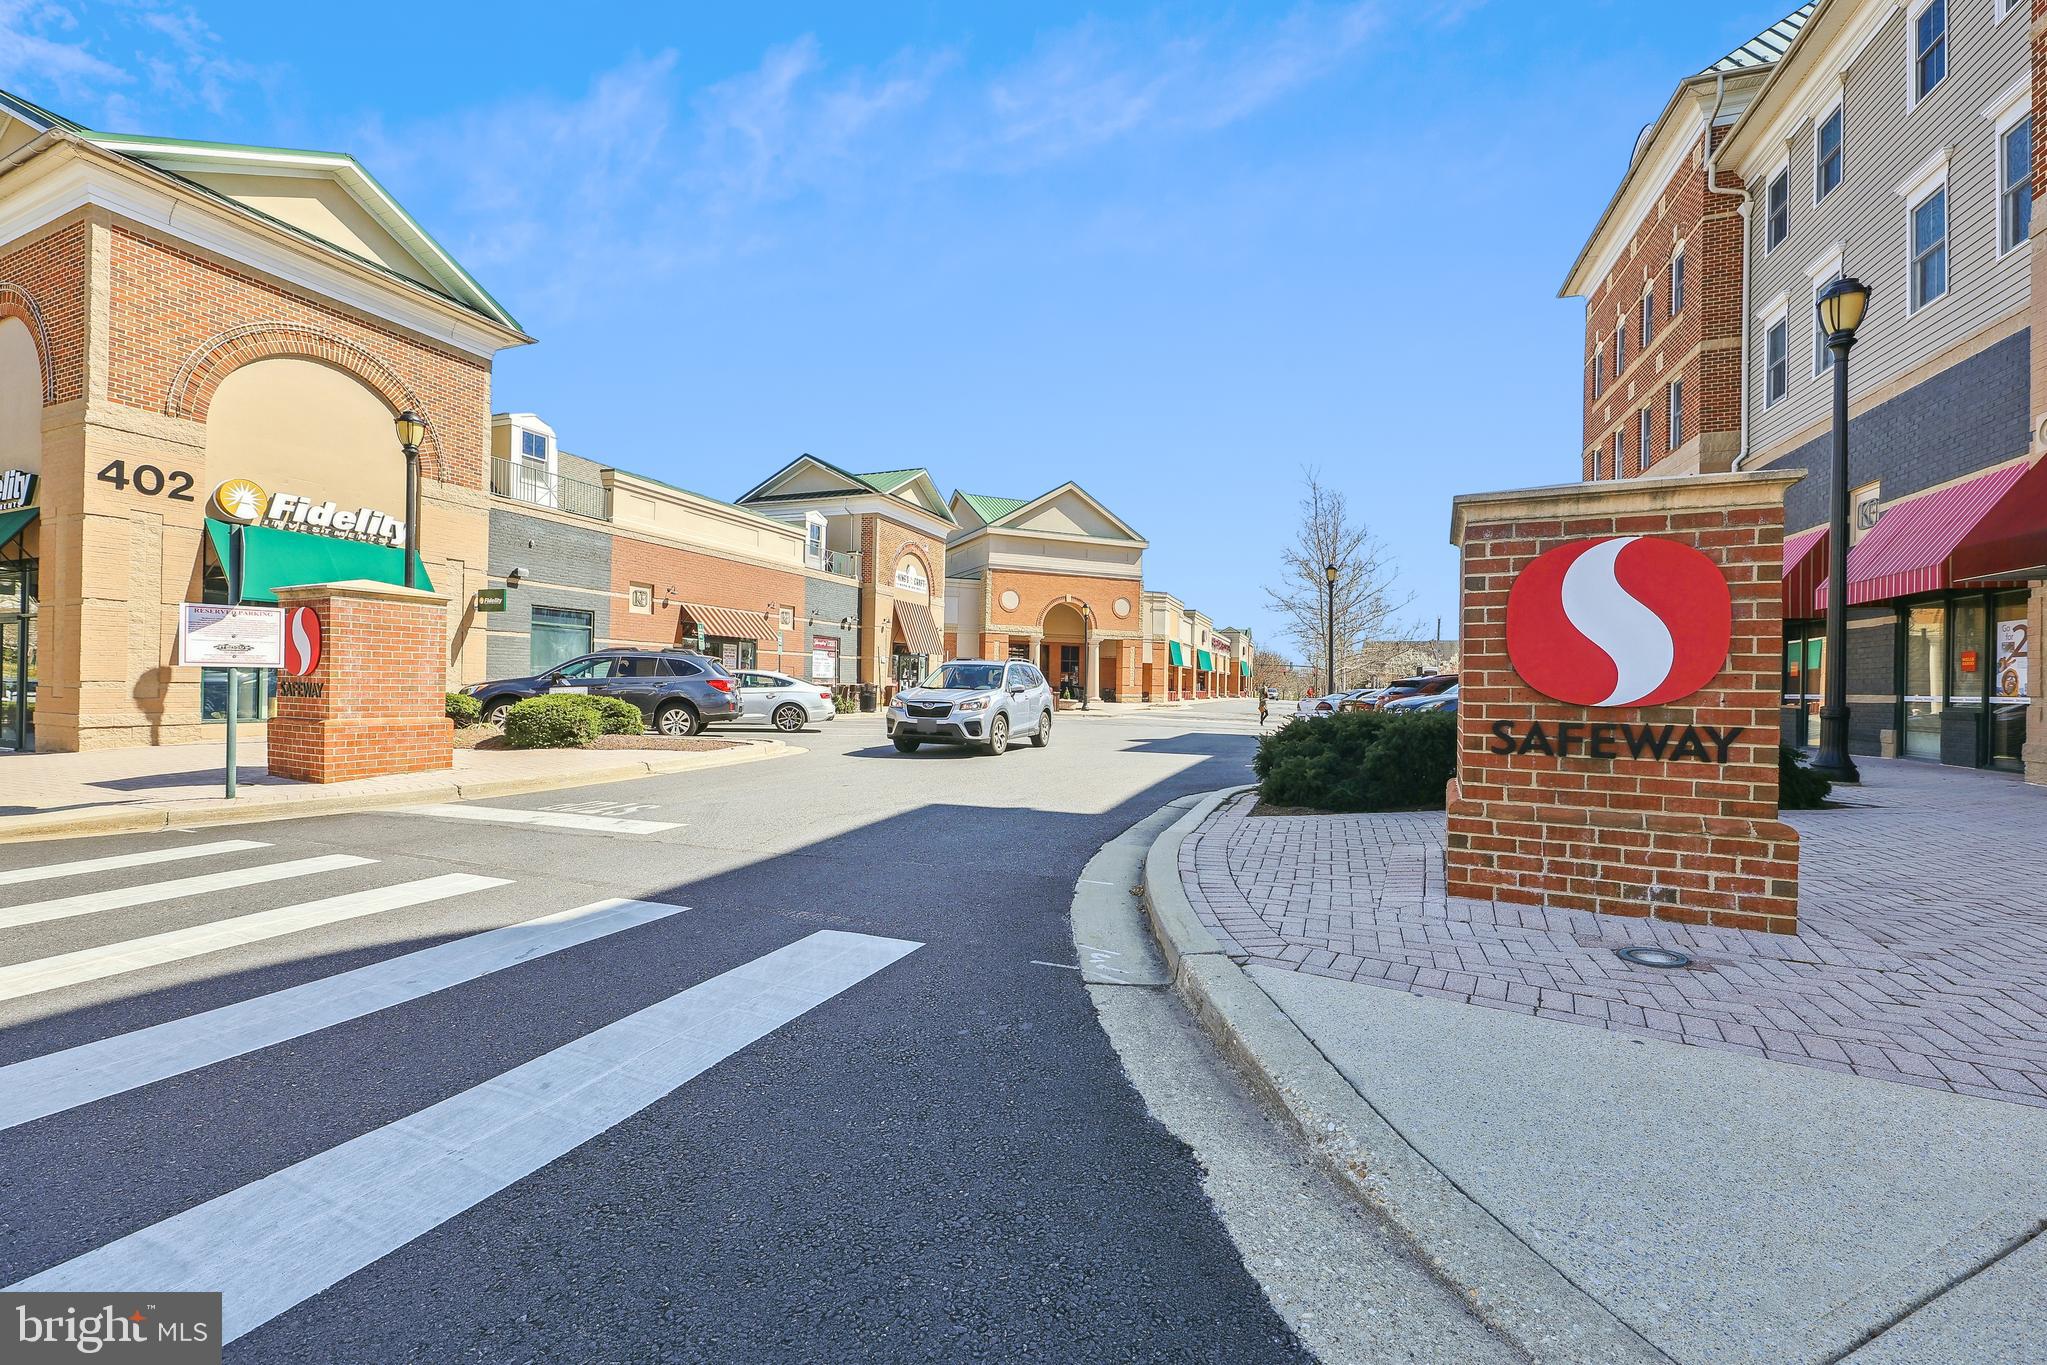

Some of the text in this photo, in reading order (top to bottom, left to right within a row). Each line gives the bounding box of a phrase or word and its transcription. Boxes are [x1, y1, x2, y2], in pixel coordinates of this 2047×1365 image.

[97, 459, 195, 502] 402
[262, 519, 389, 545] INVESTMENTS
[267, 492, 407, 546] Fidelity
[194, 608, 237, 617] RESERVED
[281, 680, 325, 698] SAFEWAY
[1491, 720, 1746, 764] SAFEWAY
